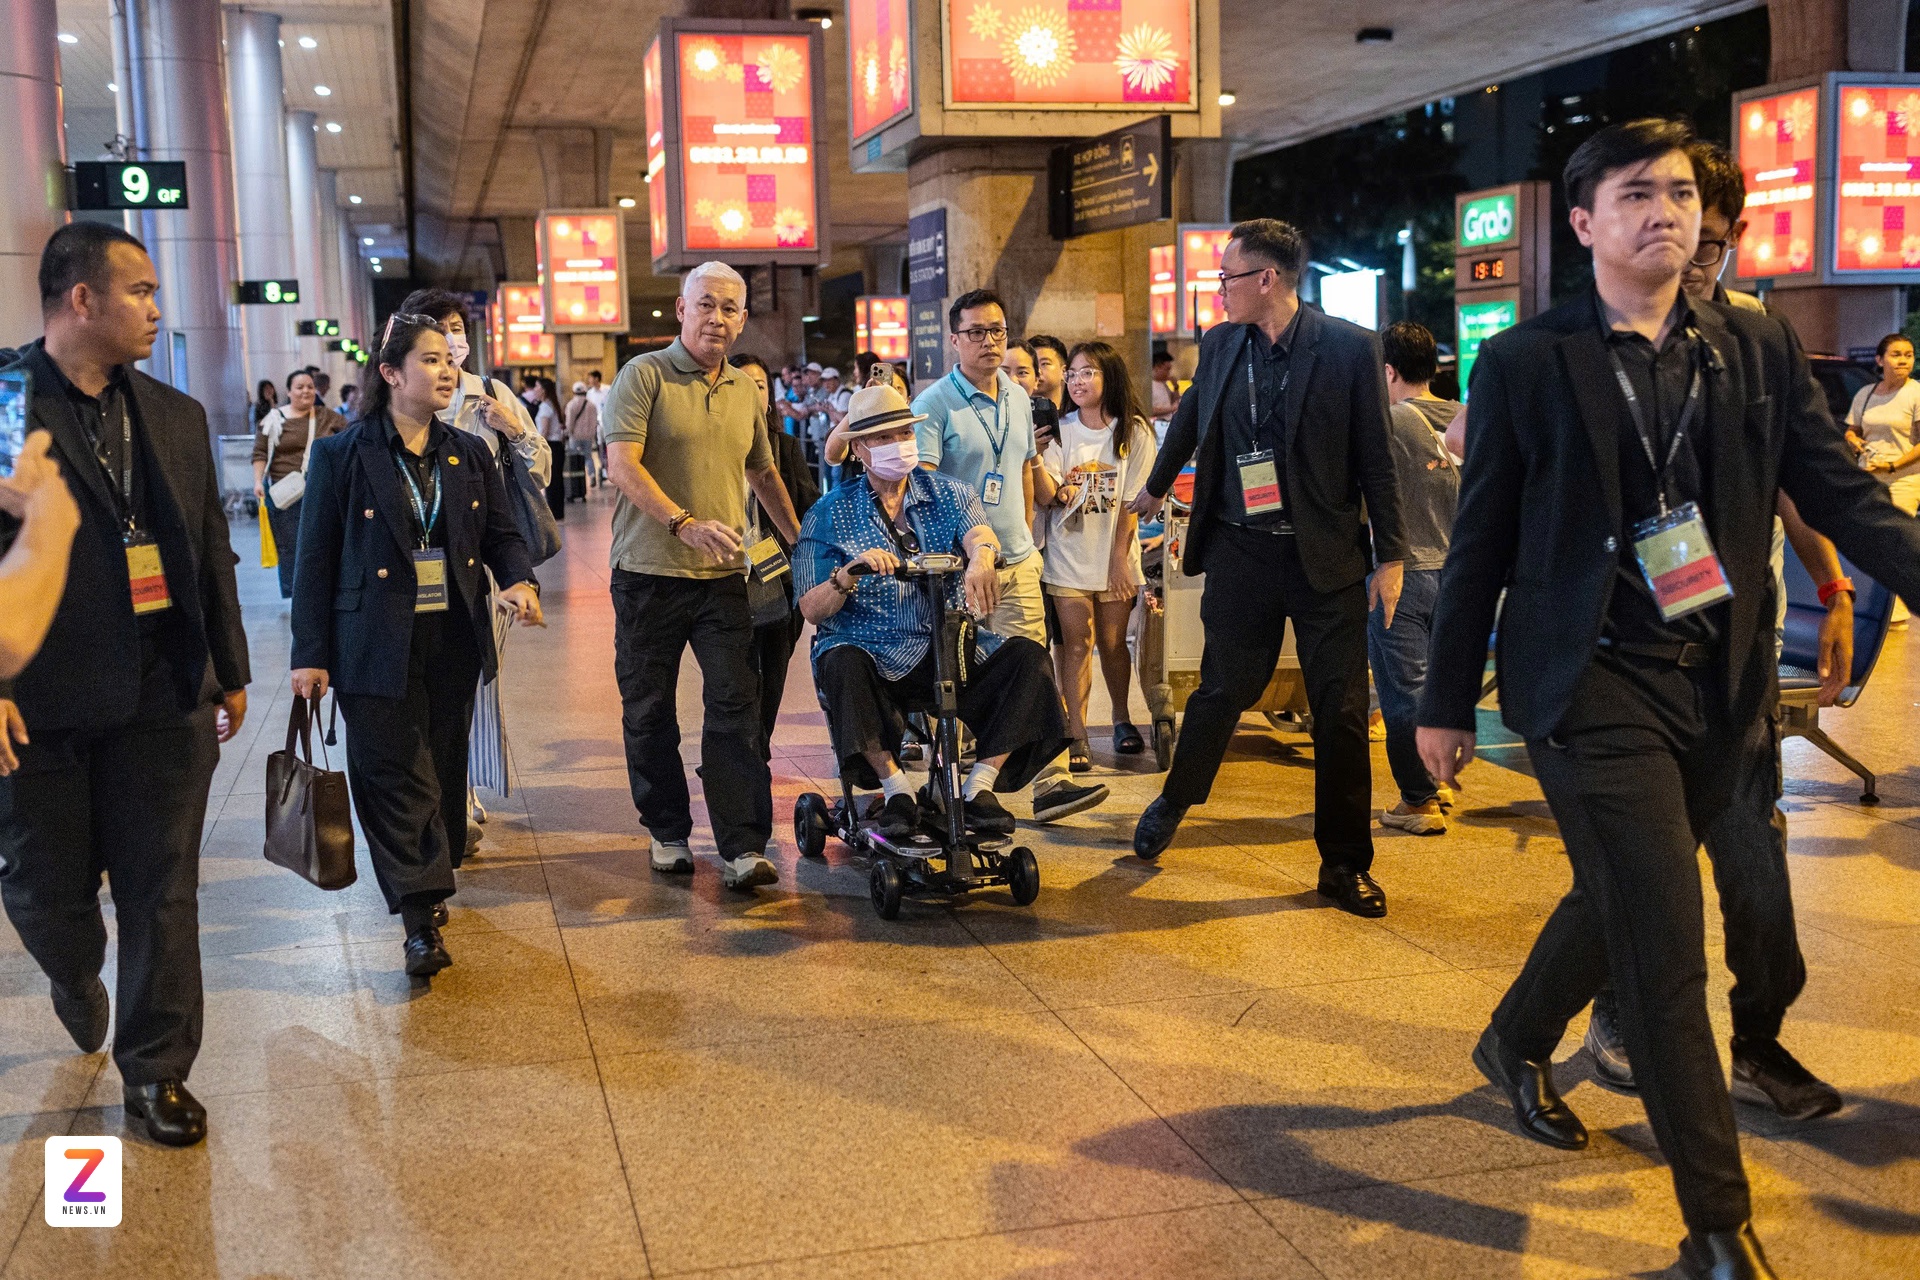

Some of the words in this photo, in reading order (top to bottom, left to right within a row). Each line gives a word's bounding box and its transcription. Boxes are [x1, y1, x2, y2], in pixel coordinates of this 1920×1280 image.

[121, 166, 149, 204] 9
[157, 188, 181, 203] GF
[1463, 200, 1513, 242] Grab
[1474, 259, 1505, 280] 19:18
[264, 282, 282, 303] 8
[315, 319, 329, 336] 7
[760, 558, 783, 573] TRANSLATOR
[1659, 569, 1712, 596] SECURITY
